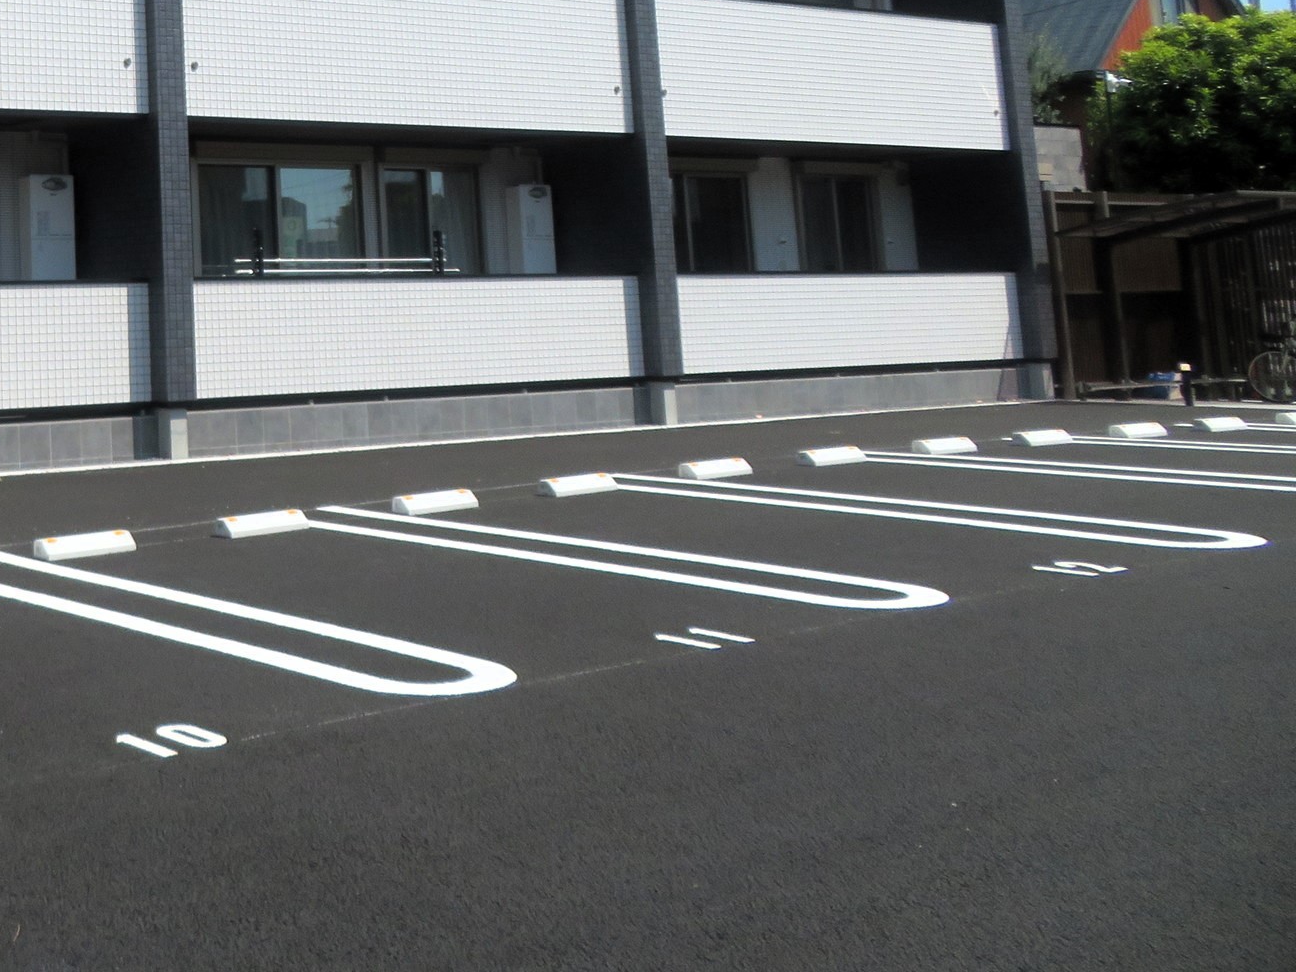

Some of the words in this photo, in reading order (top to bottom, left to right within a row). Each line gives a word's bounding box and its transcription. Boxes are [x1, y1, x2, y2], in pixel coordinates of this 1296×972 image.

[1031, 561, 1129, 577] 12
[654, 627, 756, 650] 11
[115, 724, 228, 759] 10
